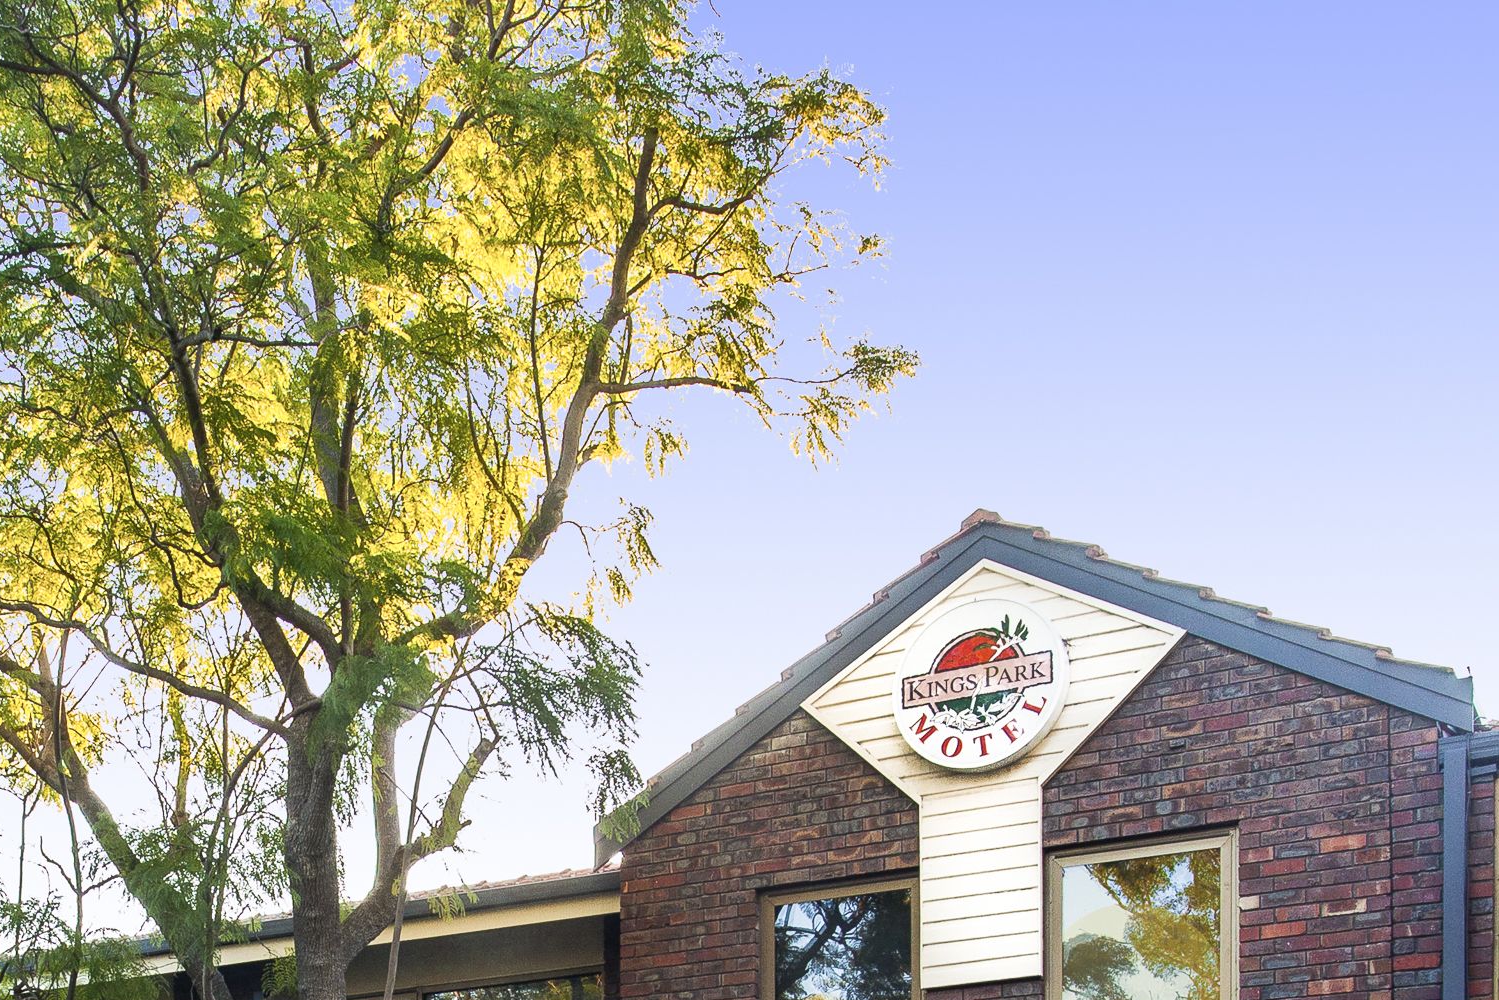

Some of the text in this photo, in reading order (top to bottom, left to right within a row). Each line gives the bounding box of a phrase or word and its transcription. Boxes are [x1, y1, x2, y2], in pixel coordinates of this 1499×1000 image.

[906, 661, 1047, 702] KINGS PARK
[909, 695, 1048, 758] MOTEL
